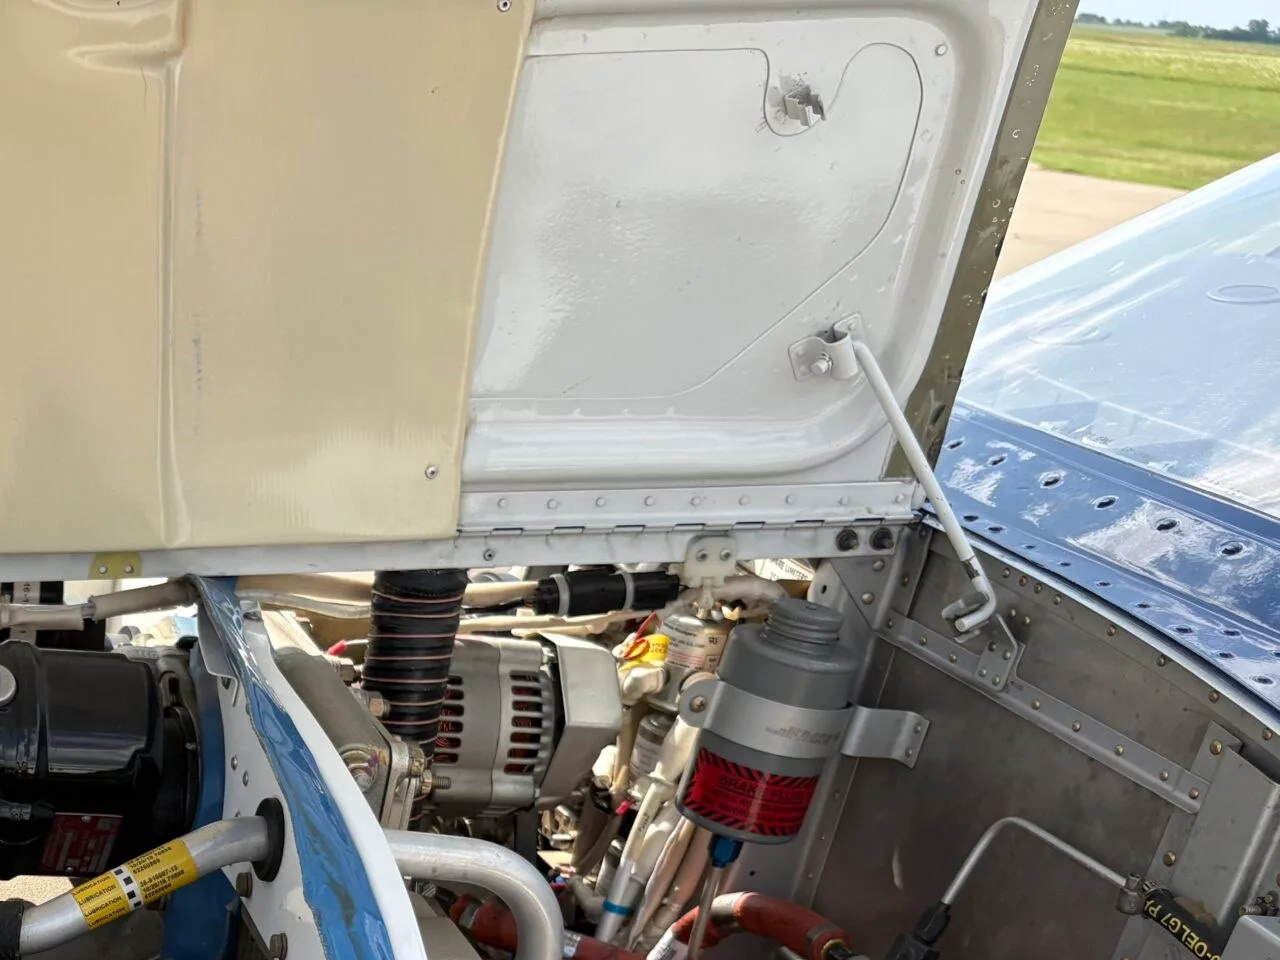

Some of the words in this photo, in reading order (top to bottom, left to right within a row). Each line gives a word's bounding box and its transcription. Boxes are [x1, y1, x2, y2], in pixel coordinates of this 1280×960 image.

[721, 774, 766, 798] BRAK
[73, 876, 110, 896] LUBRICATION
[78, 884, 116, 906] LUBRICATION
[84, 896, 122, 918] LUBRICATION
[88, 906, 126, 928] LUBRICATION
